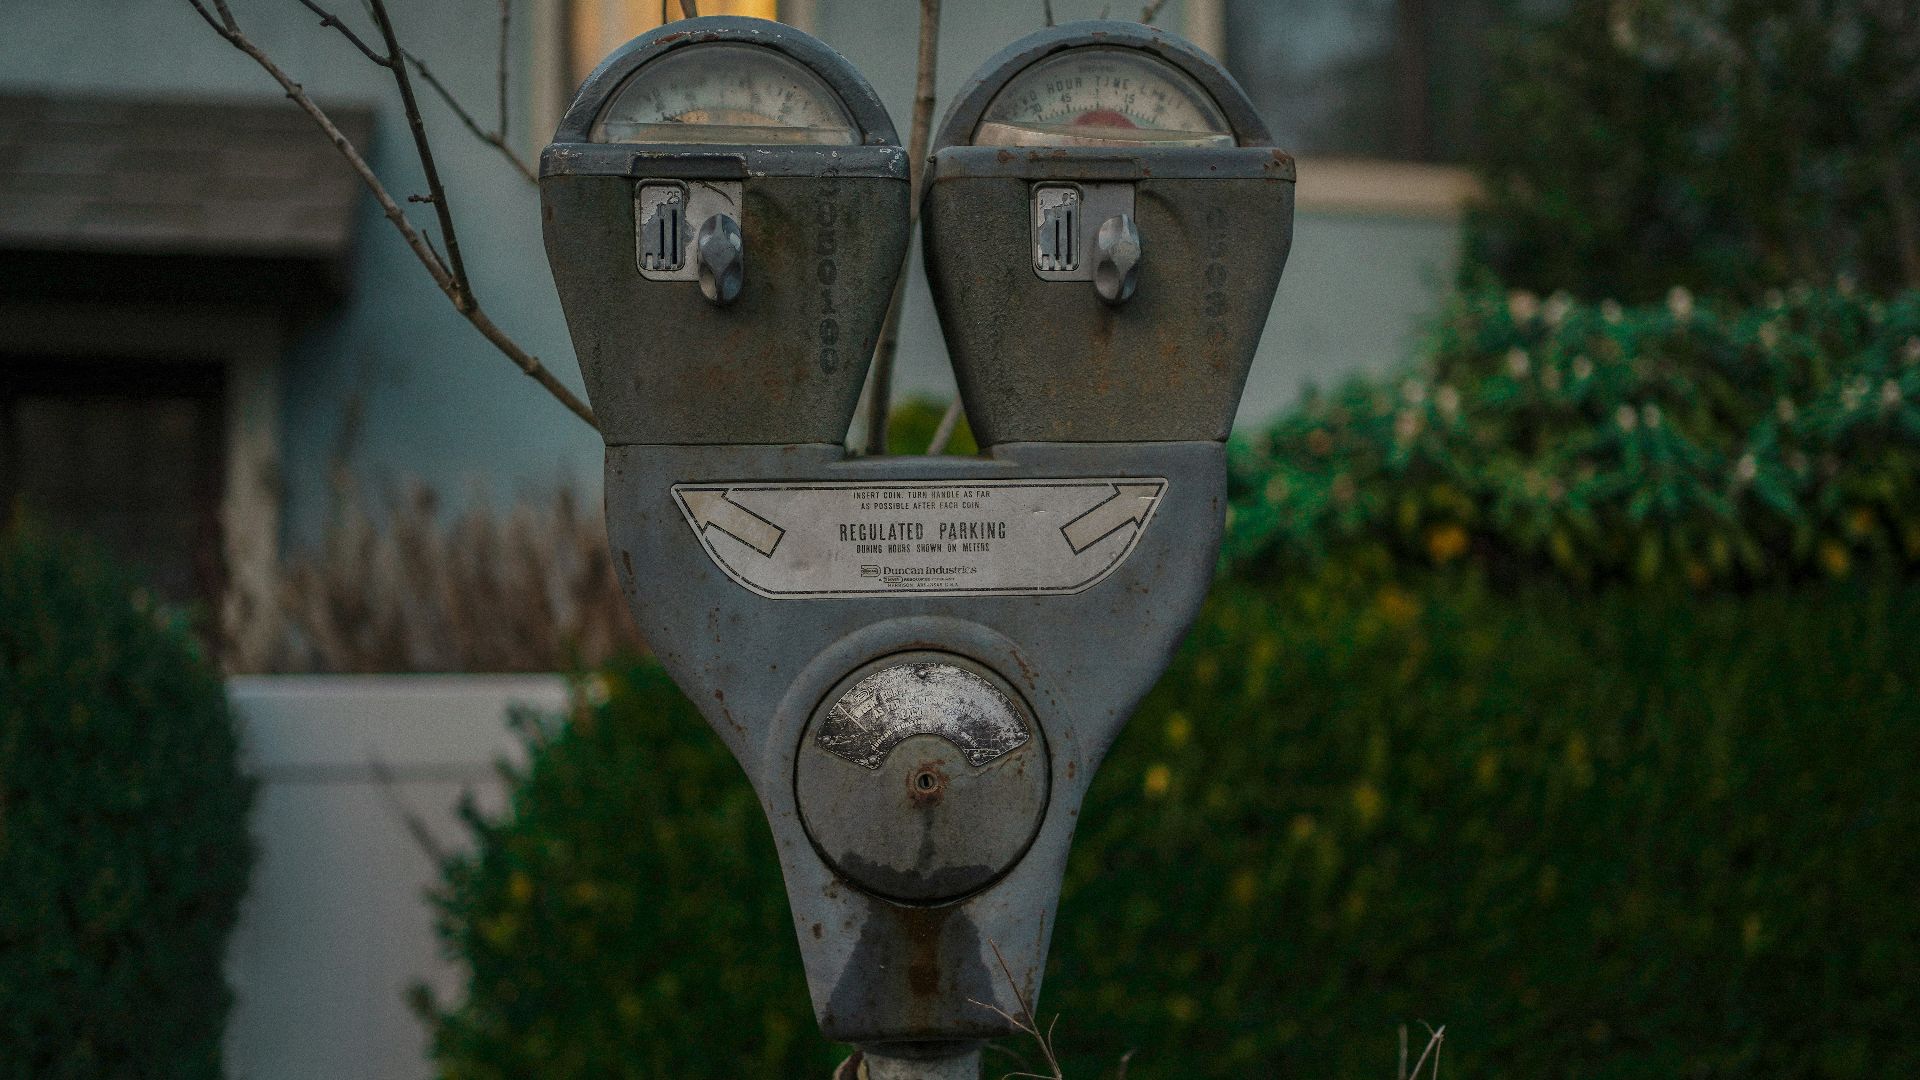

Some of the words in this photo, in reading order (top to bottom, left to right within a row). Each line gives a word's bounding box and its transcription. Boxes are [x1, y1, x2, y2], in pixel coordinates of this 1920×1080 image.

[1046, 76, 1082, 94] HOUR
[1095, 75, 1130, 90] TIME
[1060, 93, 1072, 102] 45
[1125, 94, 1136, 104] 15
[667, 191, 680, 204] 25
[853, 491, 880, 500] INSERT
[908, 491, 928, 499] TURN
[931, 490, 960, 499] HANDLE
[963, 490, 973, 498] AS
[976, 490, 991, 498] FAR
[861, 502, 871, 510] AS
[874, 502, 909, 510] POSSIBLE
[912, 501, 936, 510] AFTER
[939, 501, 958, 509] EACH
[839, 522, 924, 542] REGULATED
[939, 521, 1007, 540] PARKING
[856, 544, 883, 554] DURING
[887, 543, 911, 553] HOURS
[916, 543, 942, 553] SHOWN
[947, 543, 957, 553] ON
[962, 542, 990, 552] METERS
[883, 566, 923, 575] Duncan
[926, 565, 977, 575] Industries
